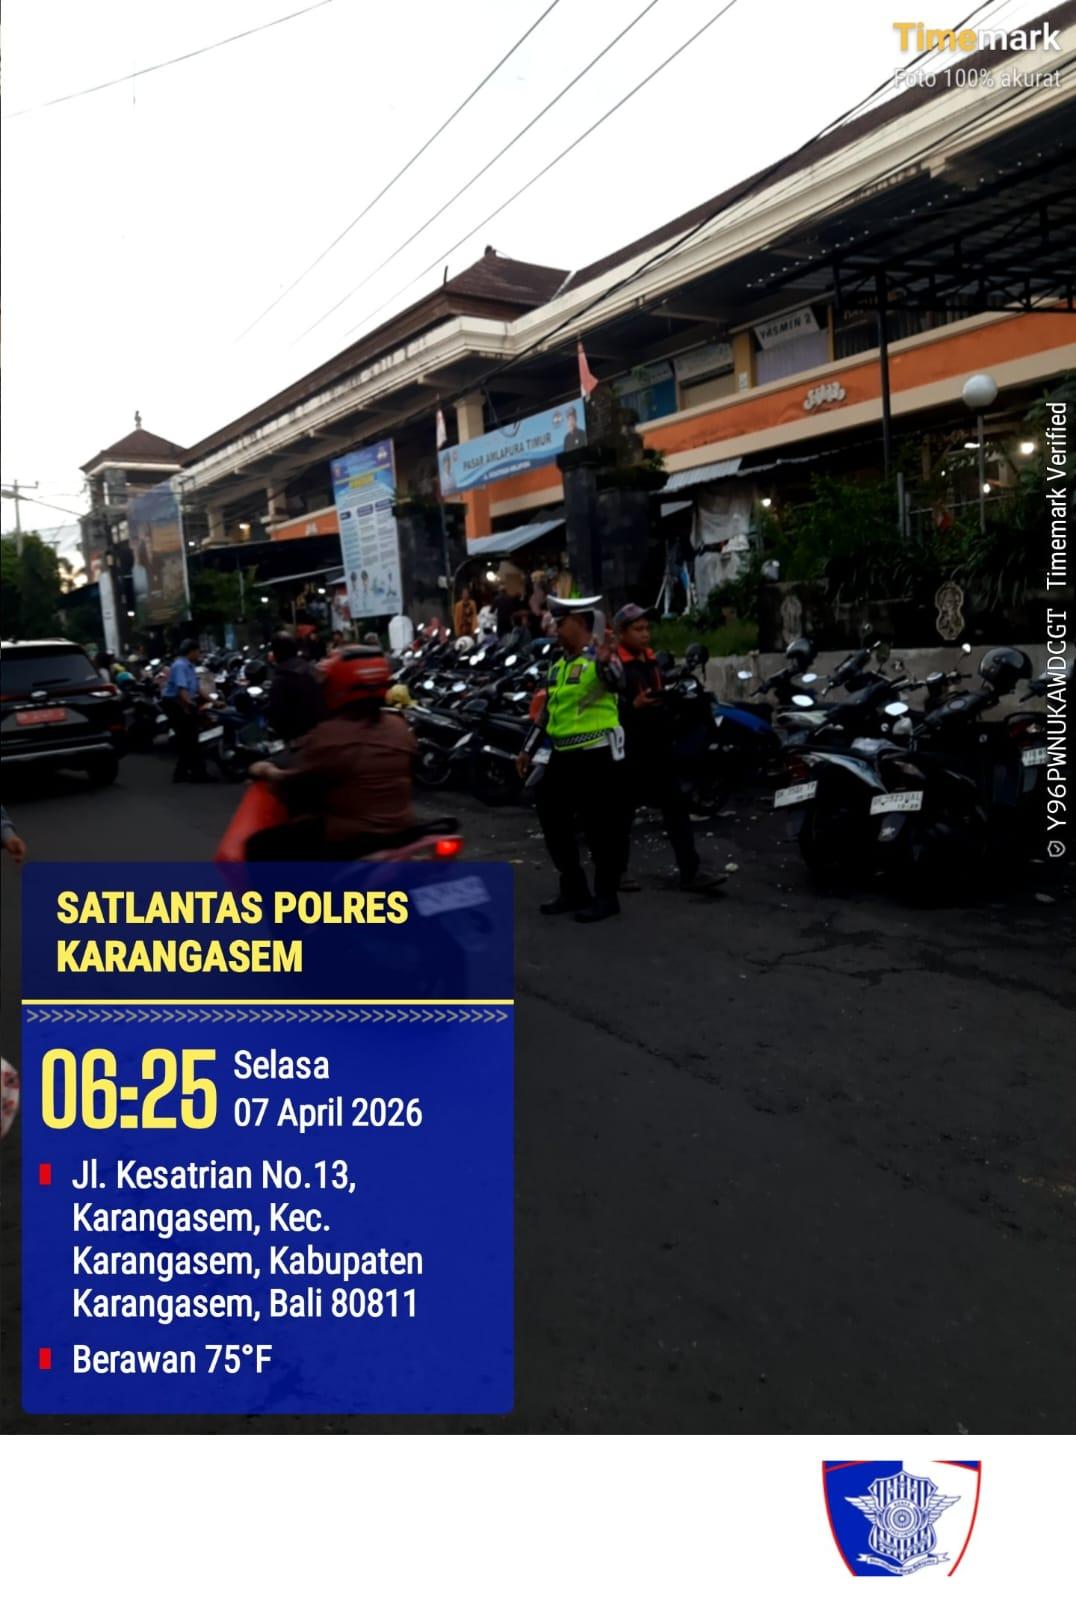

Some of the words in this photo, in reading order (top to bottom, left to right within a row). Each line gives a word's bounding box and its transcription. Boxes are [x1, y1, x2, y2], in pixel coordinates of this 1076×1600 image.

[760, 318, 802, 339] YASMIN
[463, 455, 485, 472] PASAR
[526, 432, 552, 450] TIMUR
